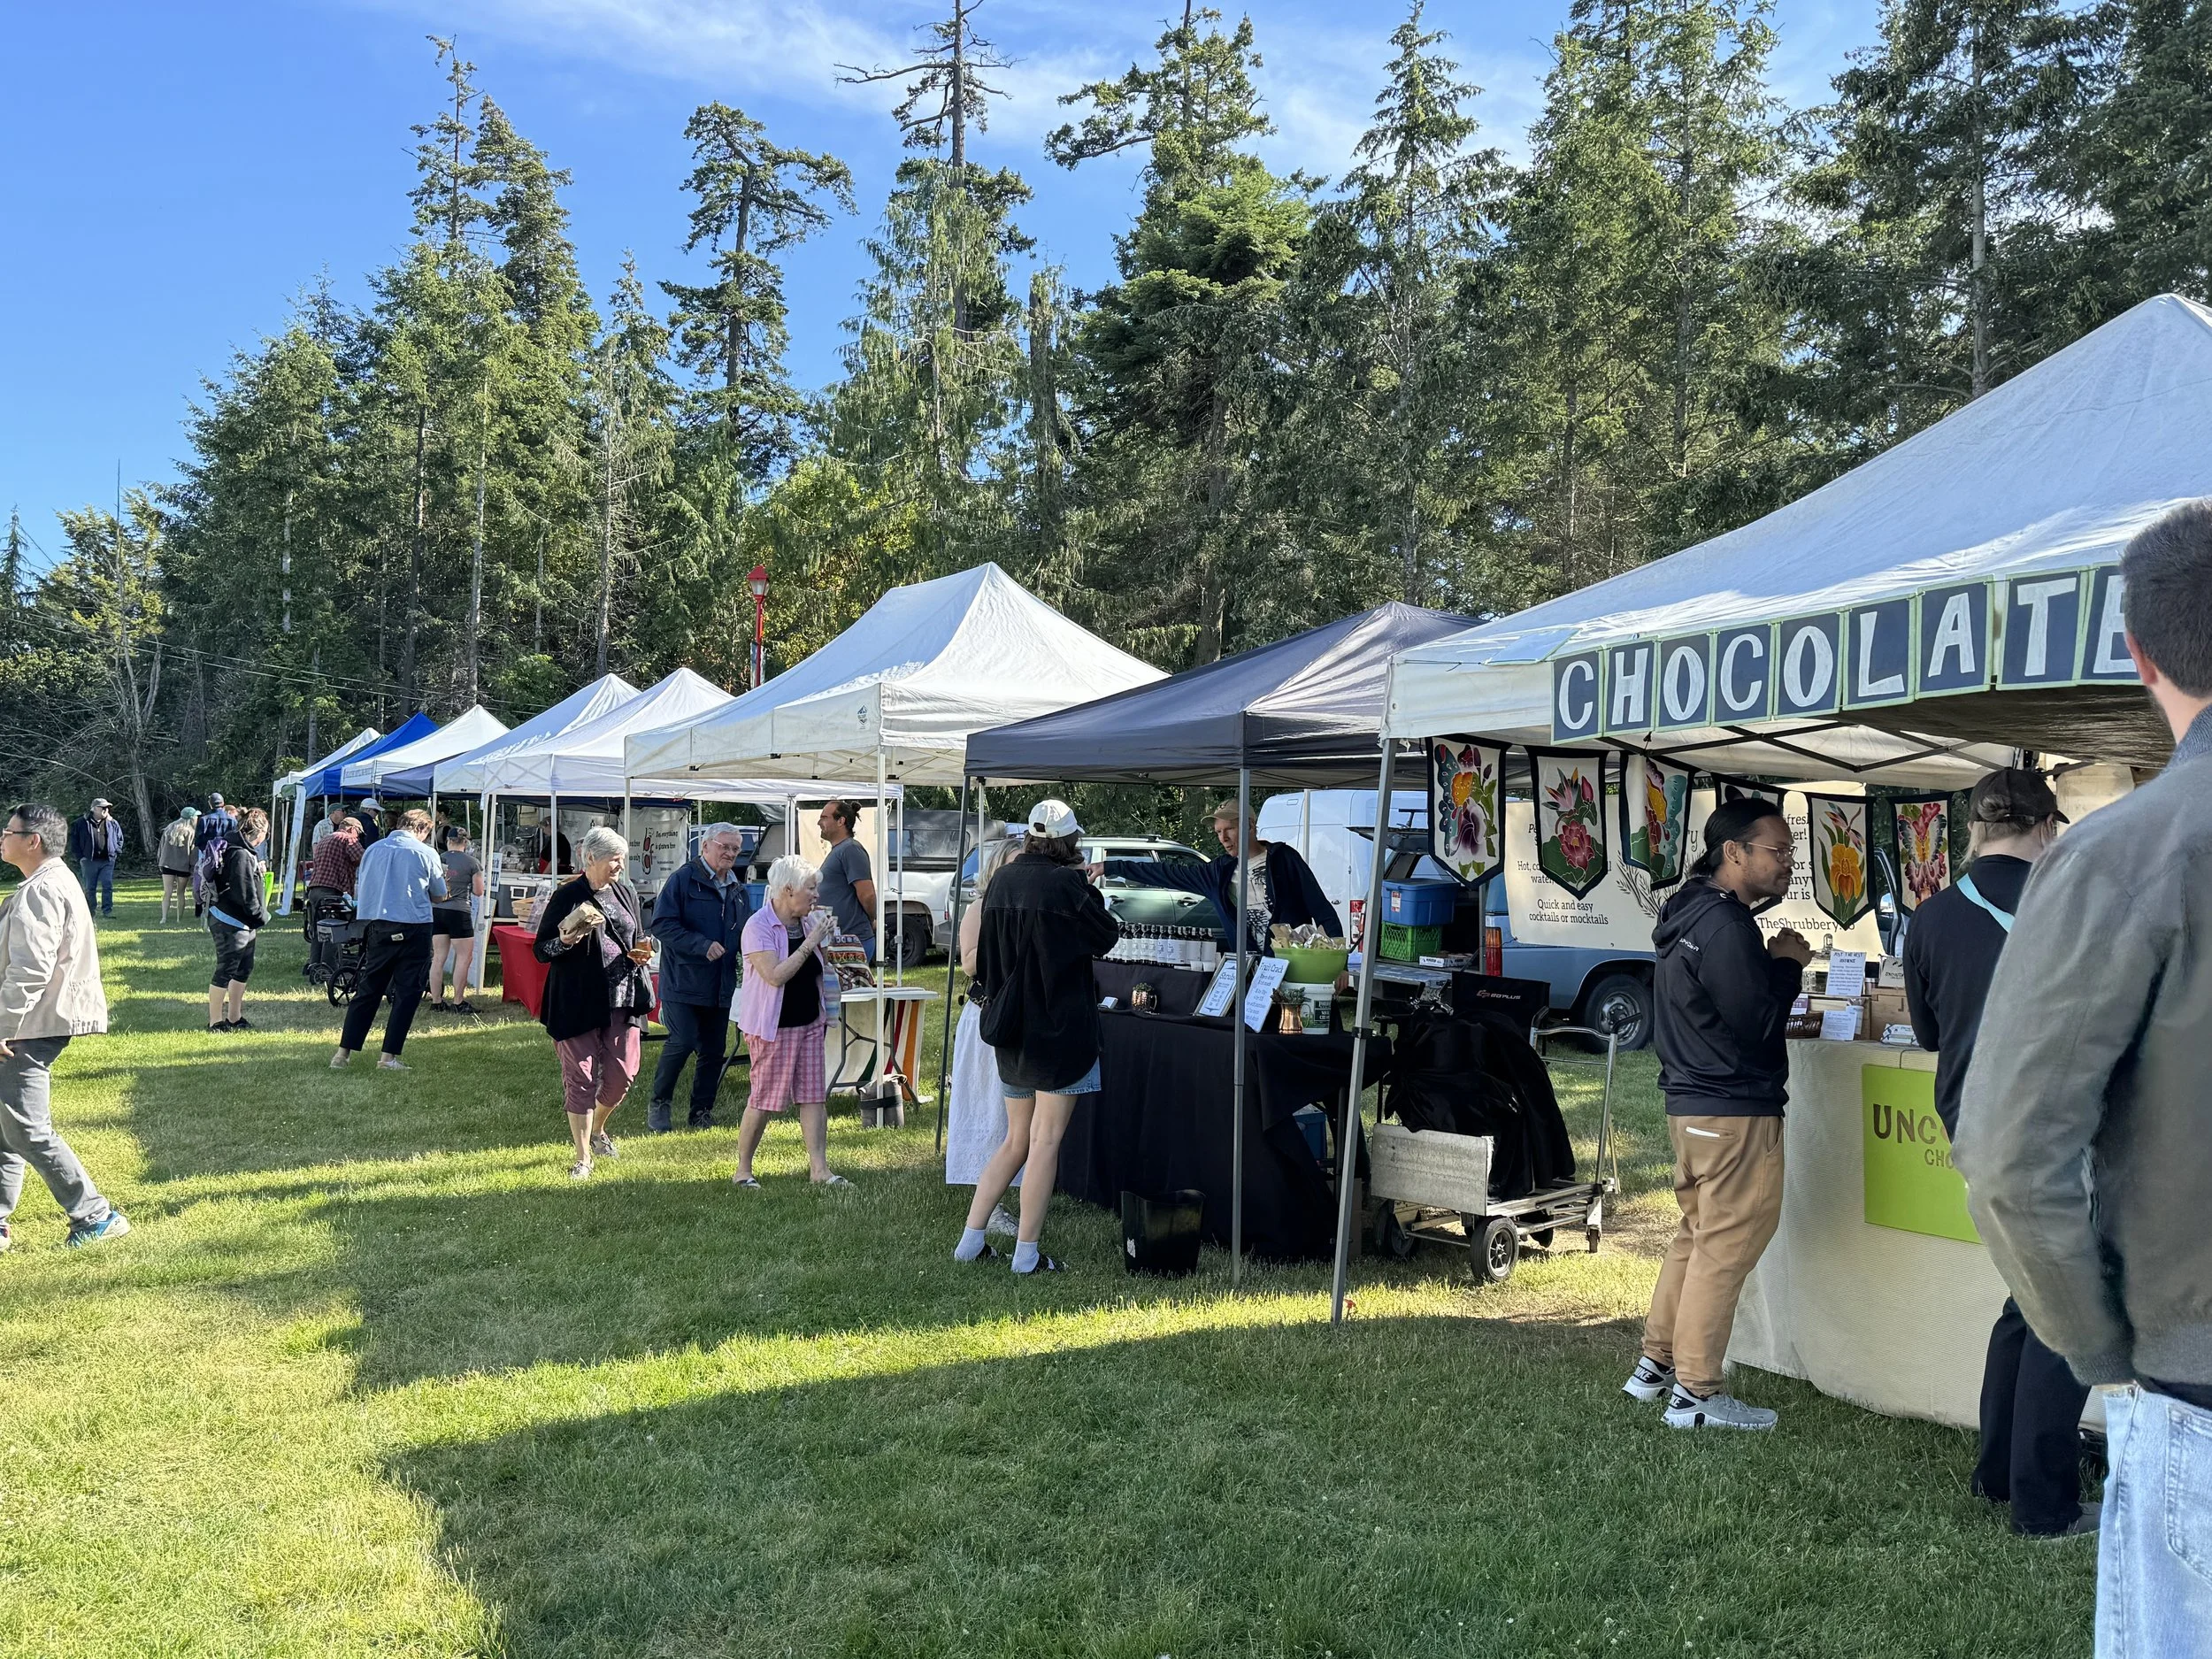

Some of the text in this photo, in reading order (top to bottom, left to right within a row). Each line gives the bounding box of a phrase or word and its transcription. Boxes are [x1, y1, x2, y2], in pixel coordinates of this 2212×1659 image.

[1558, 575, 2138, 730] CHOCOLATE
[1537, 899, 1594, 912] Quick and easy
[1529, 911, 1560, 923] cocktails
[1571, 913, 1609, 925] mocktails
